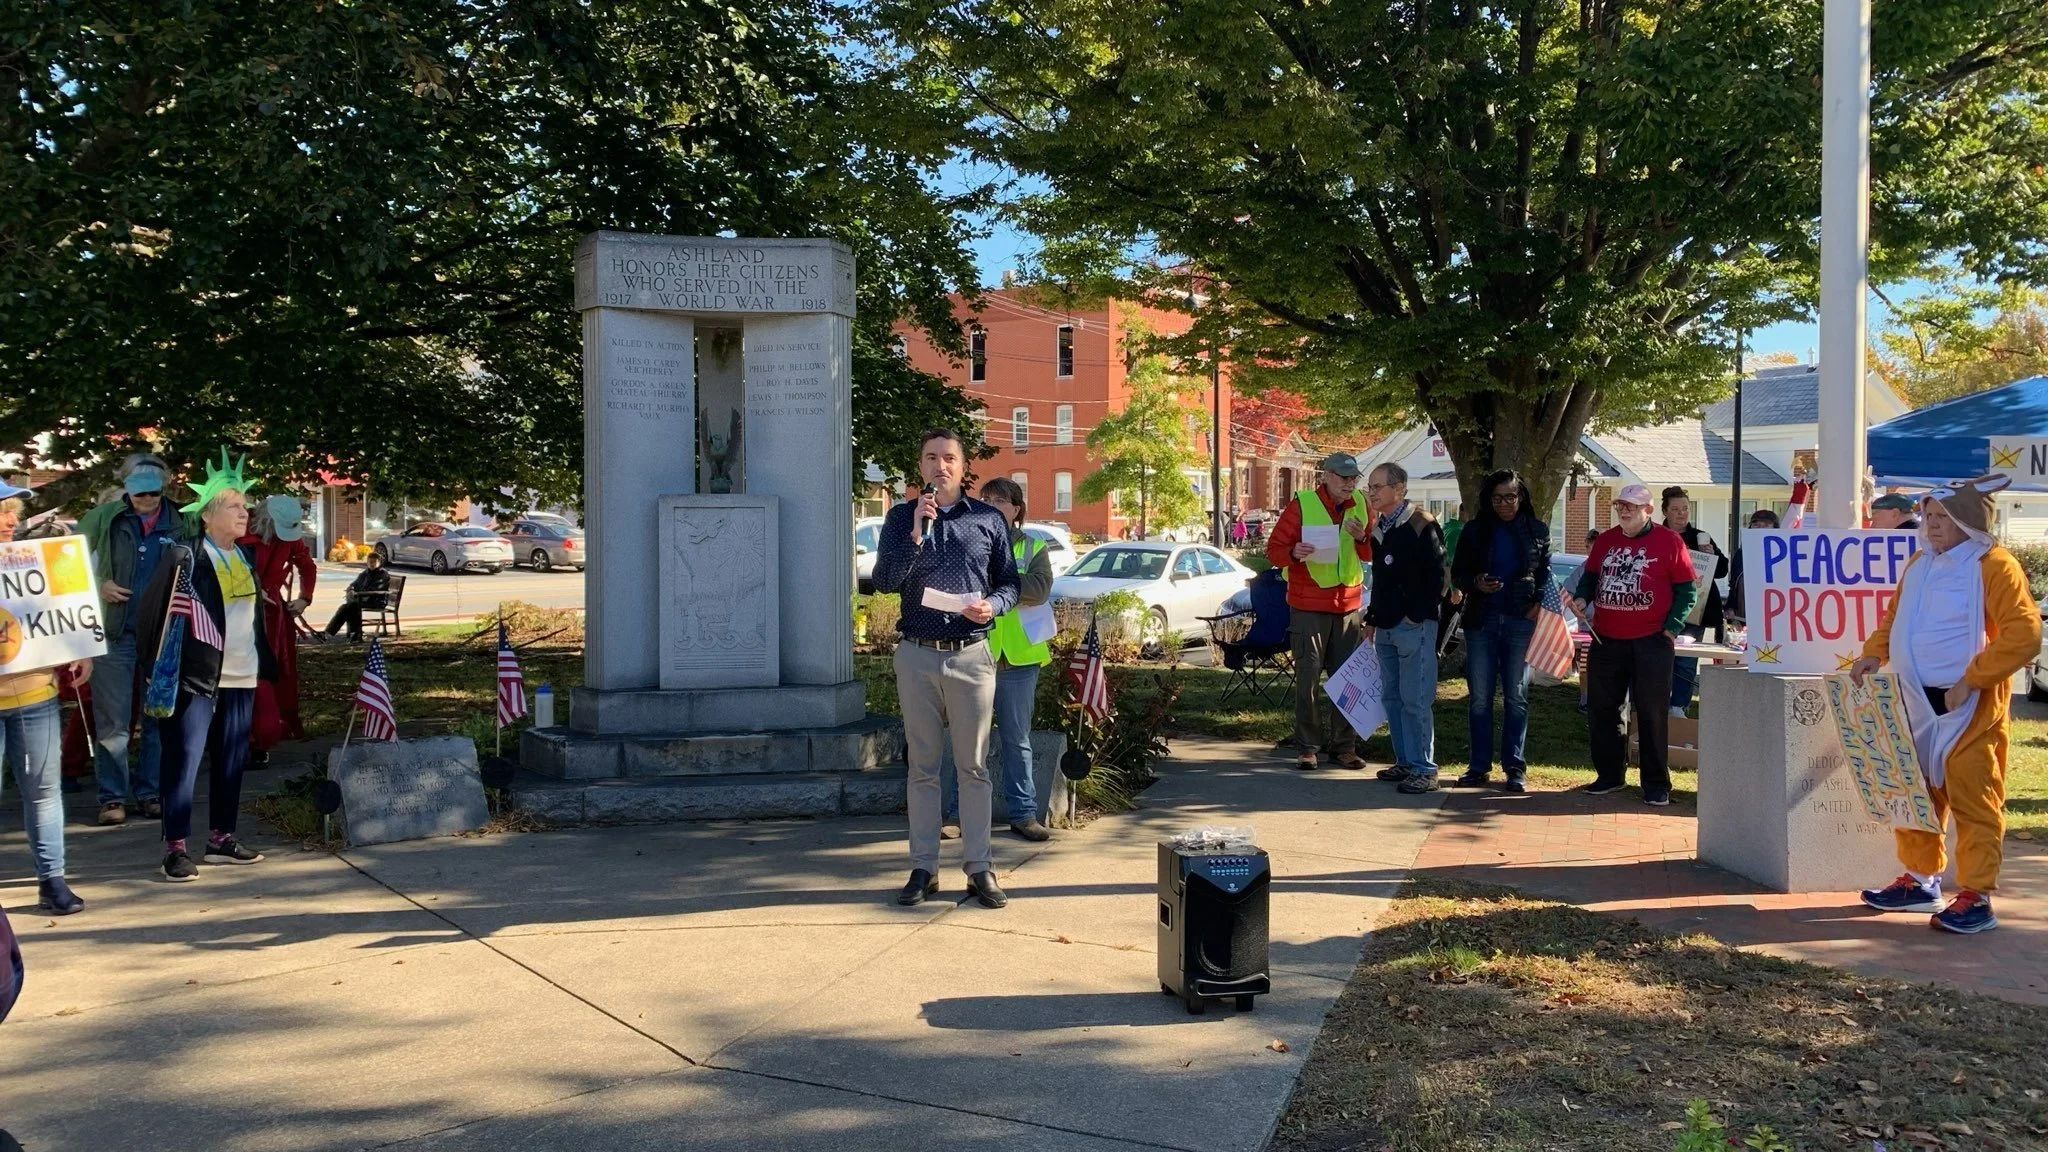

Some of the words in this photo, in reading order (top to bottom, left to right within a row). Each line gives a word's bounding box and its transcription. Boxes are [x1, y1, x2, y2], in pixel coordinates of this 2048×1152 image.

[668, 247, 765, 263] ASHLAND
[612, 259, 687, 277] HONORS
[698, 263, 731, 278] HER
[740, 265, 819, 280] CITIZENS
[623, 275, 666, 291] WHO
[674, 278, 740, 294] SERVED
[748, 280, 767, 294] IN
[774, 281, 807, 294] THE
[605, 293, 632, 305] 1917
[658, 293, 726, 309] WORLD
[735, 296, 775, 310] WAR
[801, 299, 827, 309] 1918
[611, 338, 642, 348] KILLED
[645, 340, 654, 349] IN
[656, 342, 686, 352] ACTION
[753, 344, 774, 353] DIED
[776, 343, 786, 352] IN
[788, 342, 822, 352] SERVICE
[617, 356, 641, 366] JAMES
[749, 364, 775, 373] PHILIP
[789, 362, 826, 371] BELLOWS
[611, 379, 646, 388] GORDON
[795, 377, 819, 386] DAVIS
[783, 391, 827, 401] THOMPSON
[607, 401, 645, 411] RICHARD
[656, 404, 690, 413] MURPHY
[750, 408, 785, 417] FRANCIS
[794, 407, 826, 416] WILSON
[2031, 444, 2047, 476] N
[1, 569, 46, 599] NO
[1340, 643, 1374, 682] HANDS
[1874, 677, 1901, 742] Please
[1897, 745, 1914, 786] Join
[371, 775, 386, 785] THE
[1801, 778, 1814, 792] OF
[1812, 800, 1852, 814] UNITED
[1837, 822, 1848, 836] IN
[1855, 822, 1878, 835] WAR
